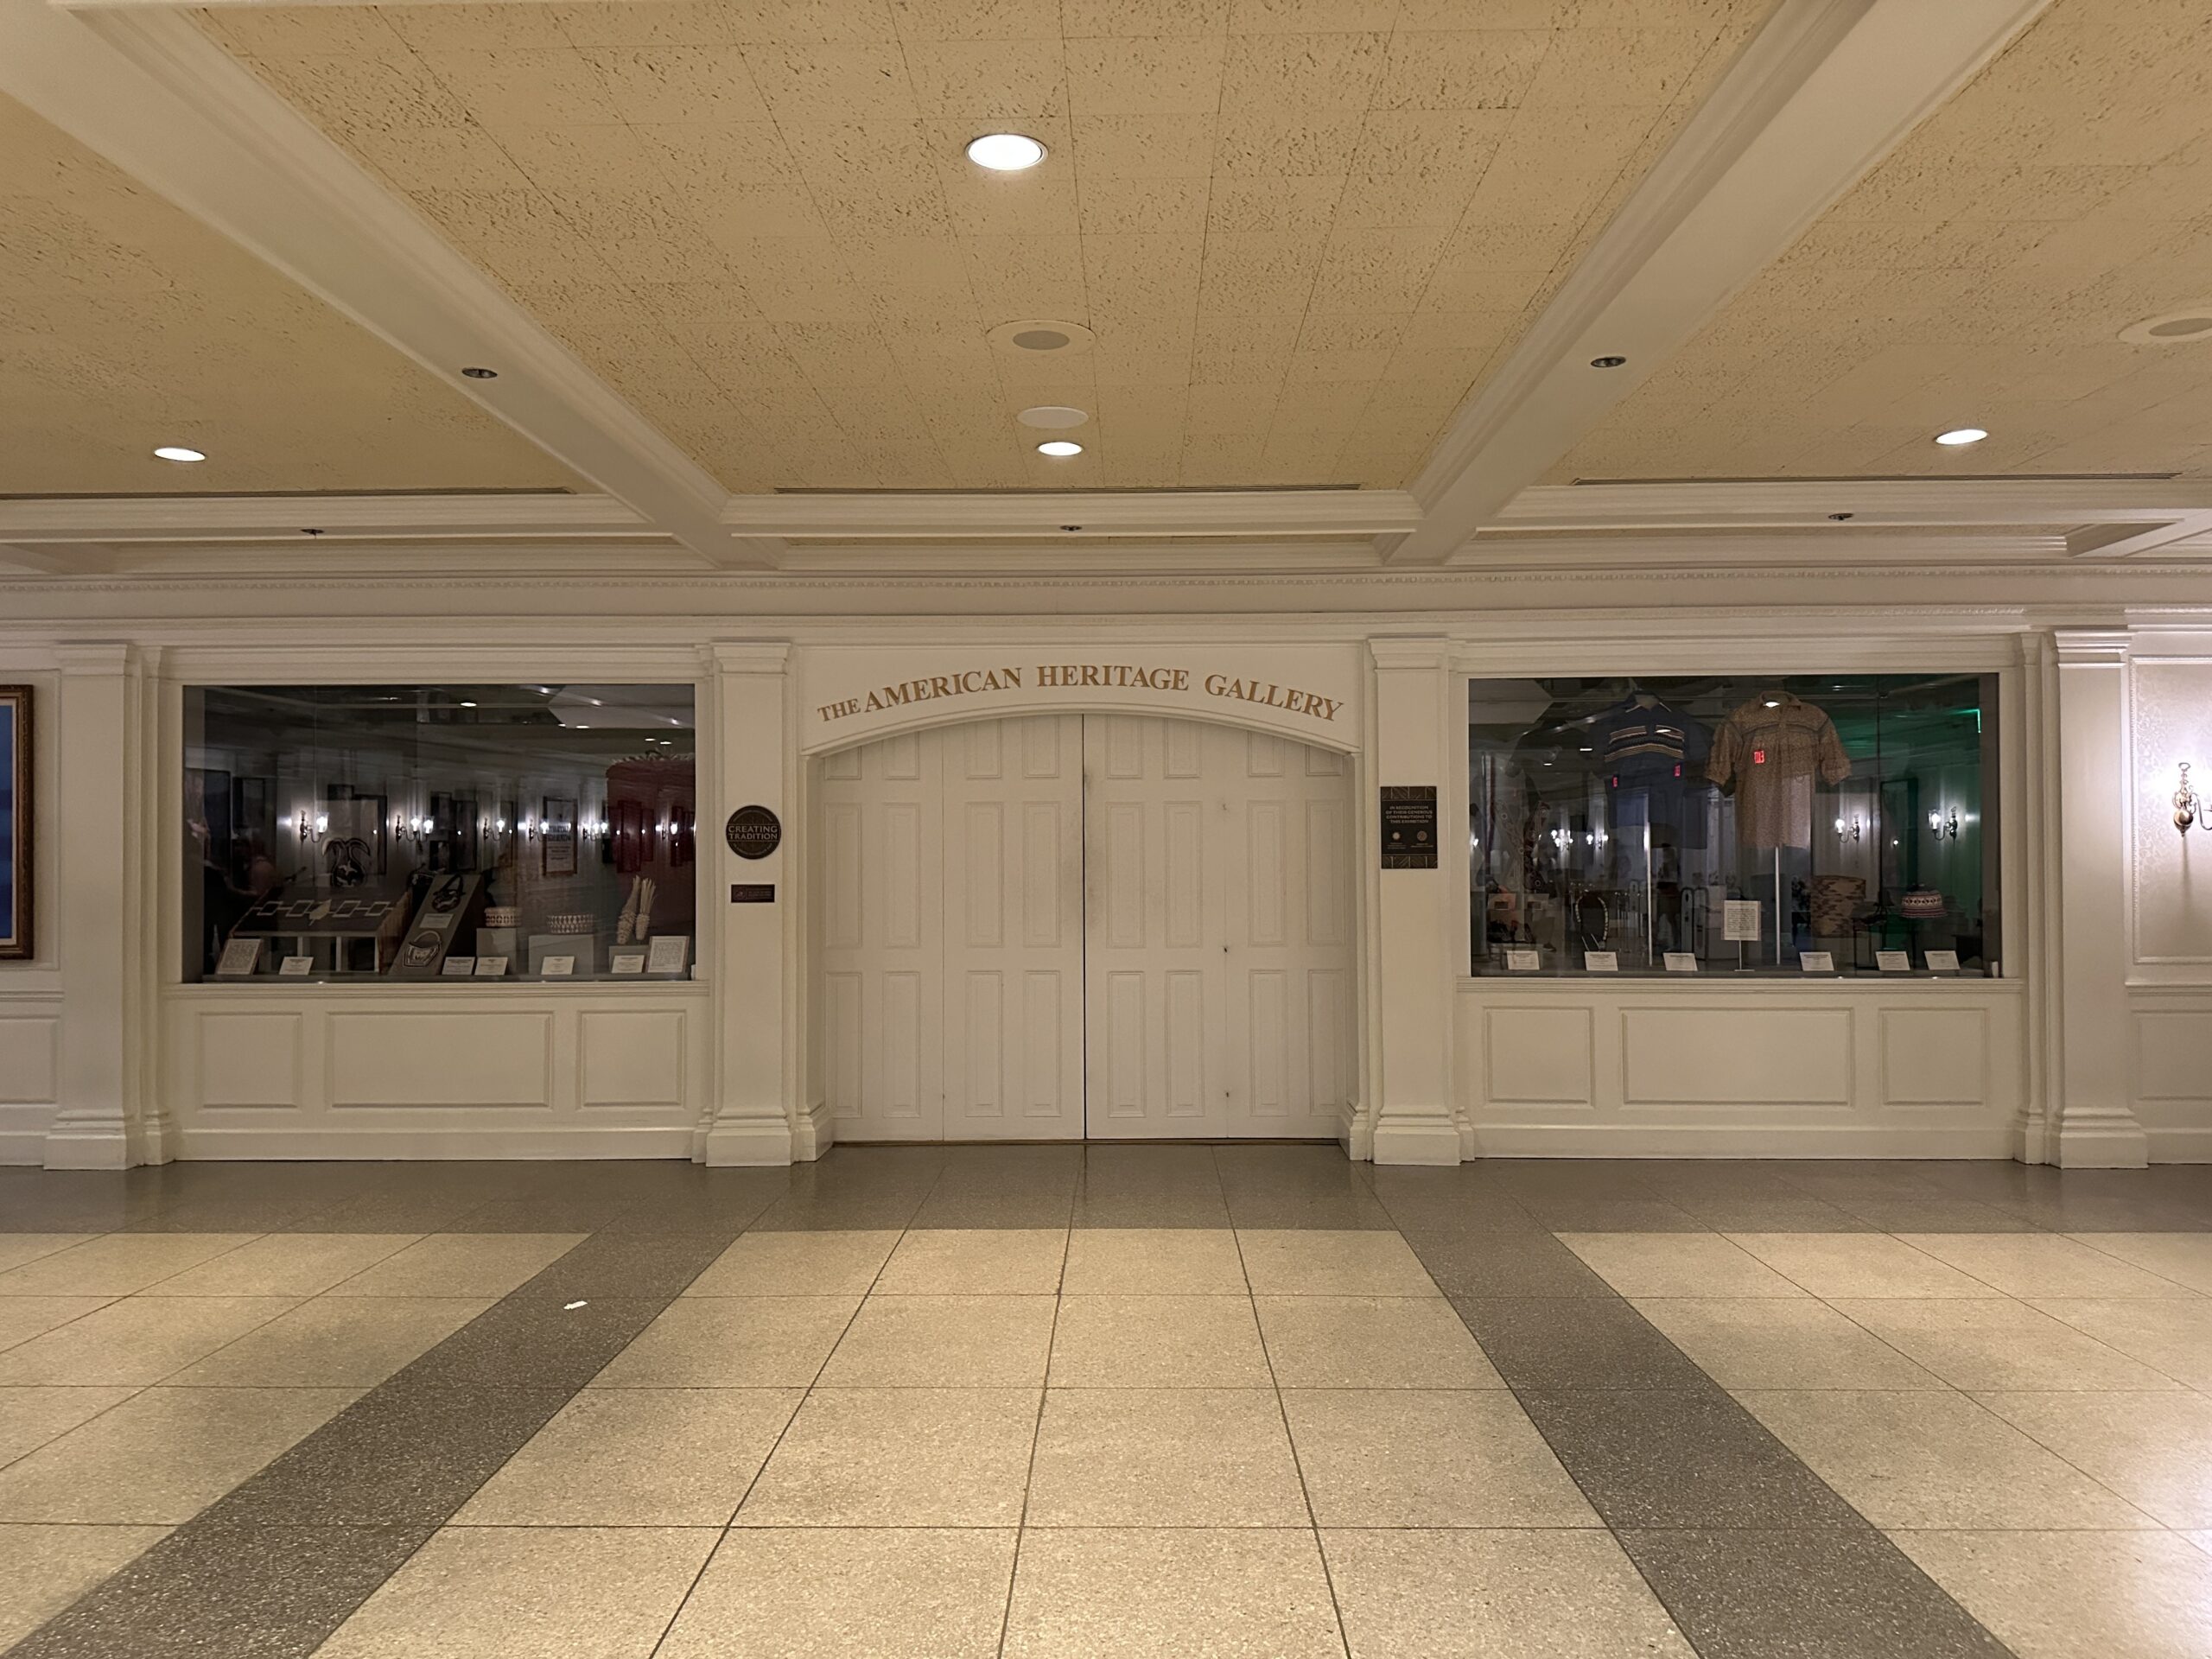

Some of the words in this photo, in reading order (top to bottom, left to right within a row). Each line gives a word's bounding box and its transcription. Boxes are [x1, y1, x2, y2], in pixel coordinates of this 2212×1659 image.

[817, 698, 861, 722] THE
[864, 667, 1022, 713] AMERICAN
[1036, 664, 1189, 691] HERITAGE
[1205, 674, 1344, 721] GALLERY
